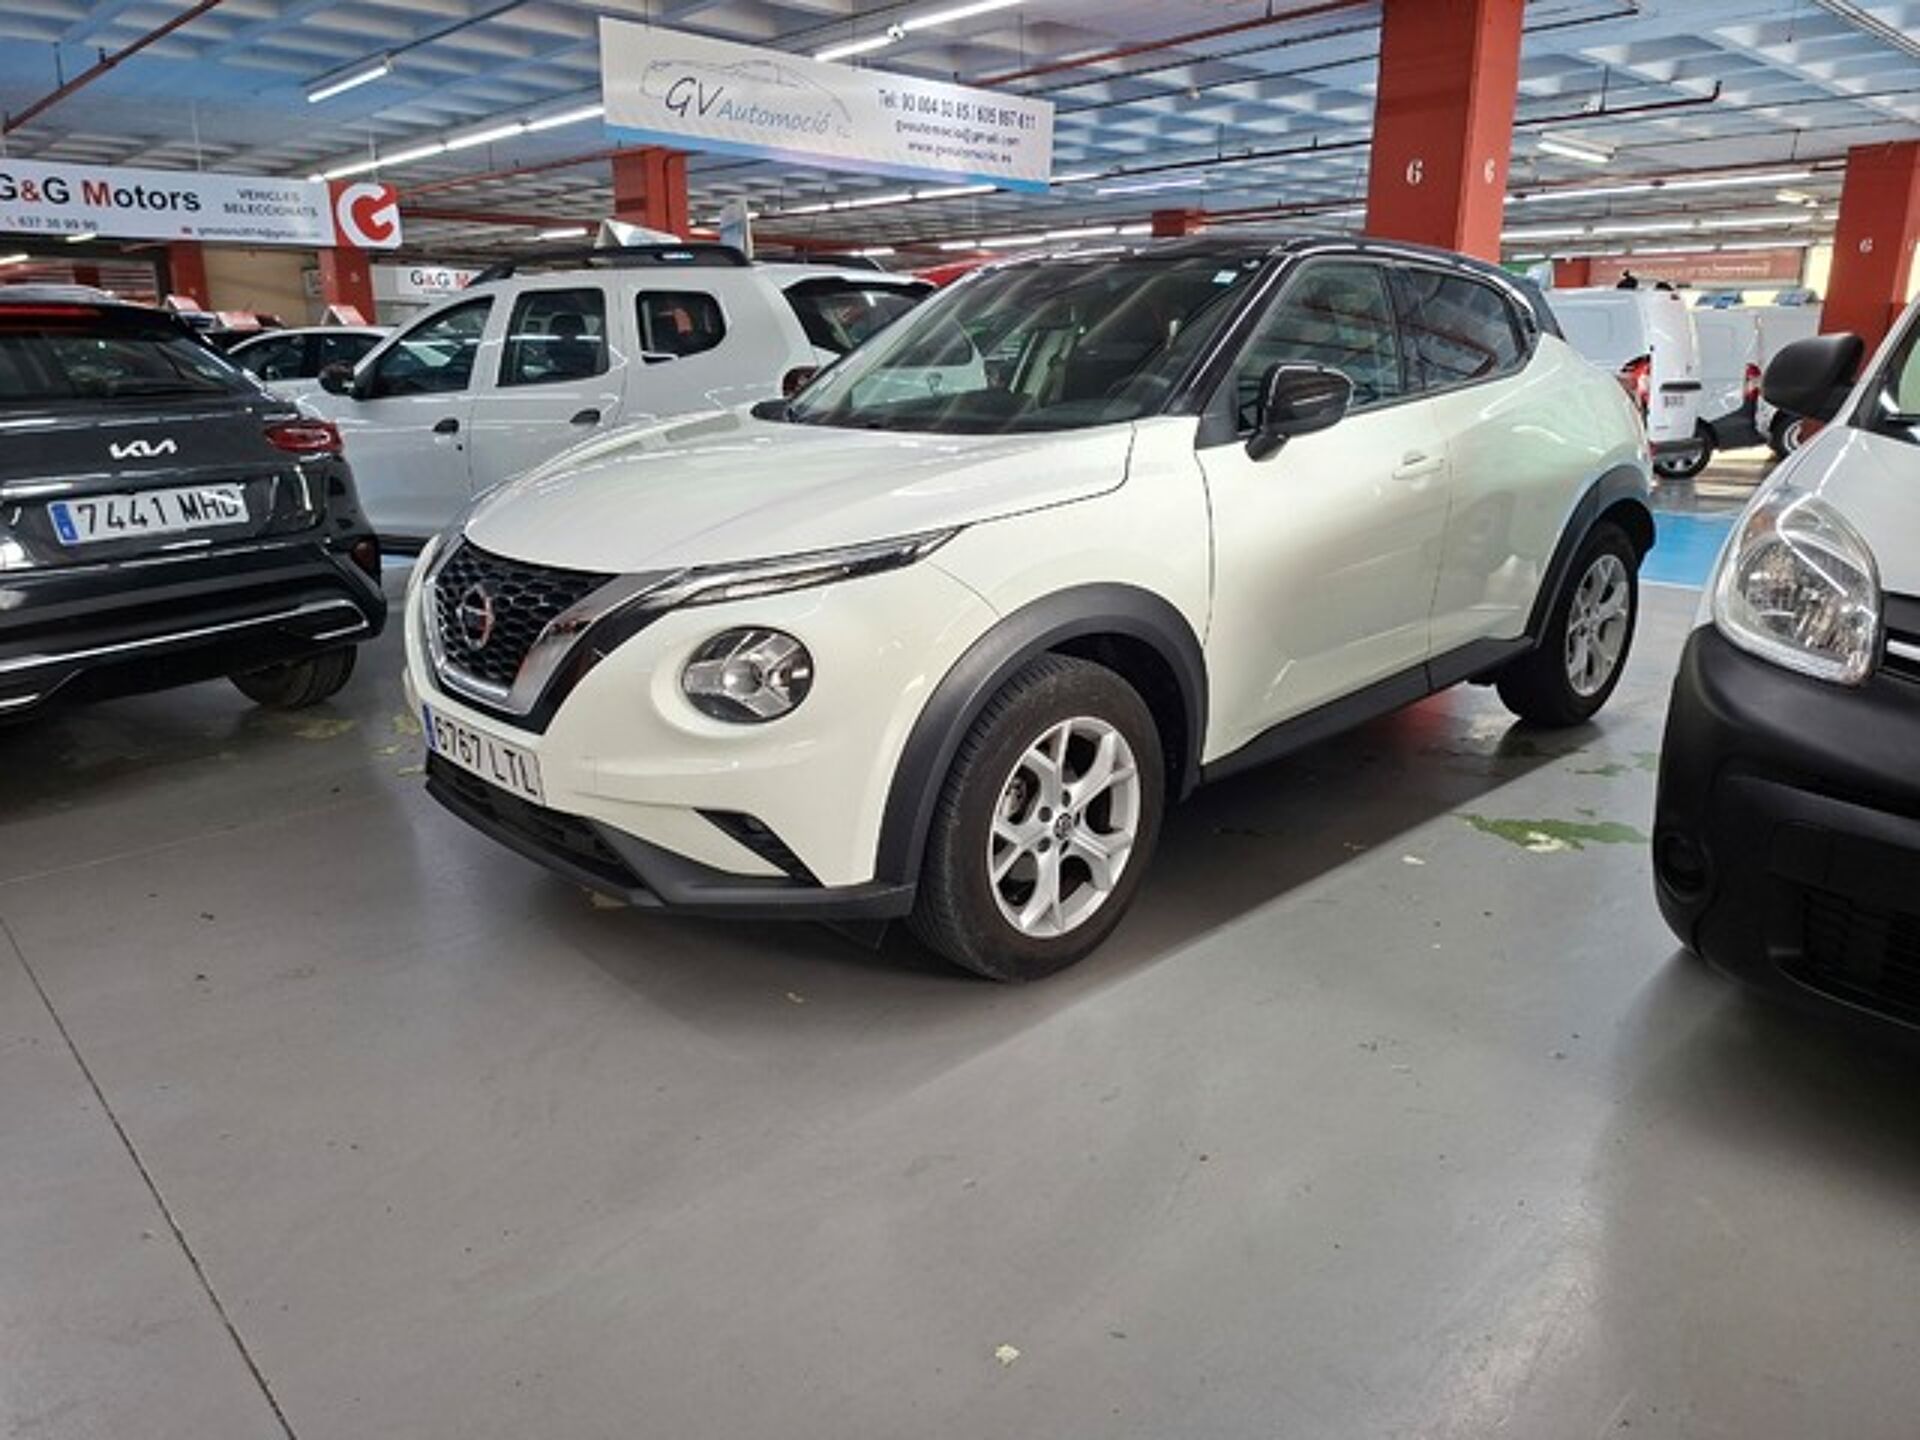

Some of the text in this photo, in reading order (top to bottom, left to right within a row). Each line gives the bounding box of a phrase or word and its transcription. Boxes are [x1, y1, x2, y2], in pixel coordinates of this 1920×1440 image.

[665, 76, 832, 135] GV Automoció
[1406, 159, 1423, 186] 6
[1484, 158, 1495, 184] 6
[0, 172, 202, 213] G&G Motors
[336, 182, 401, 248] G
[77, 496, 168, 535] 7441
[488, 741, 538, 797] LTL
